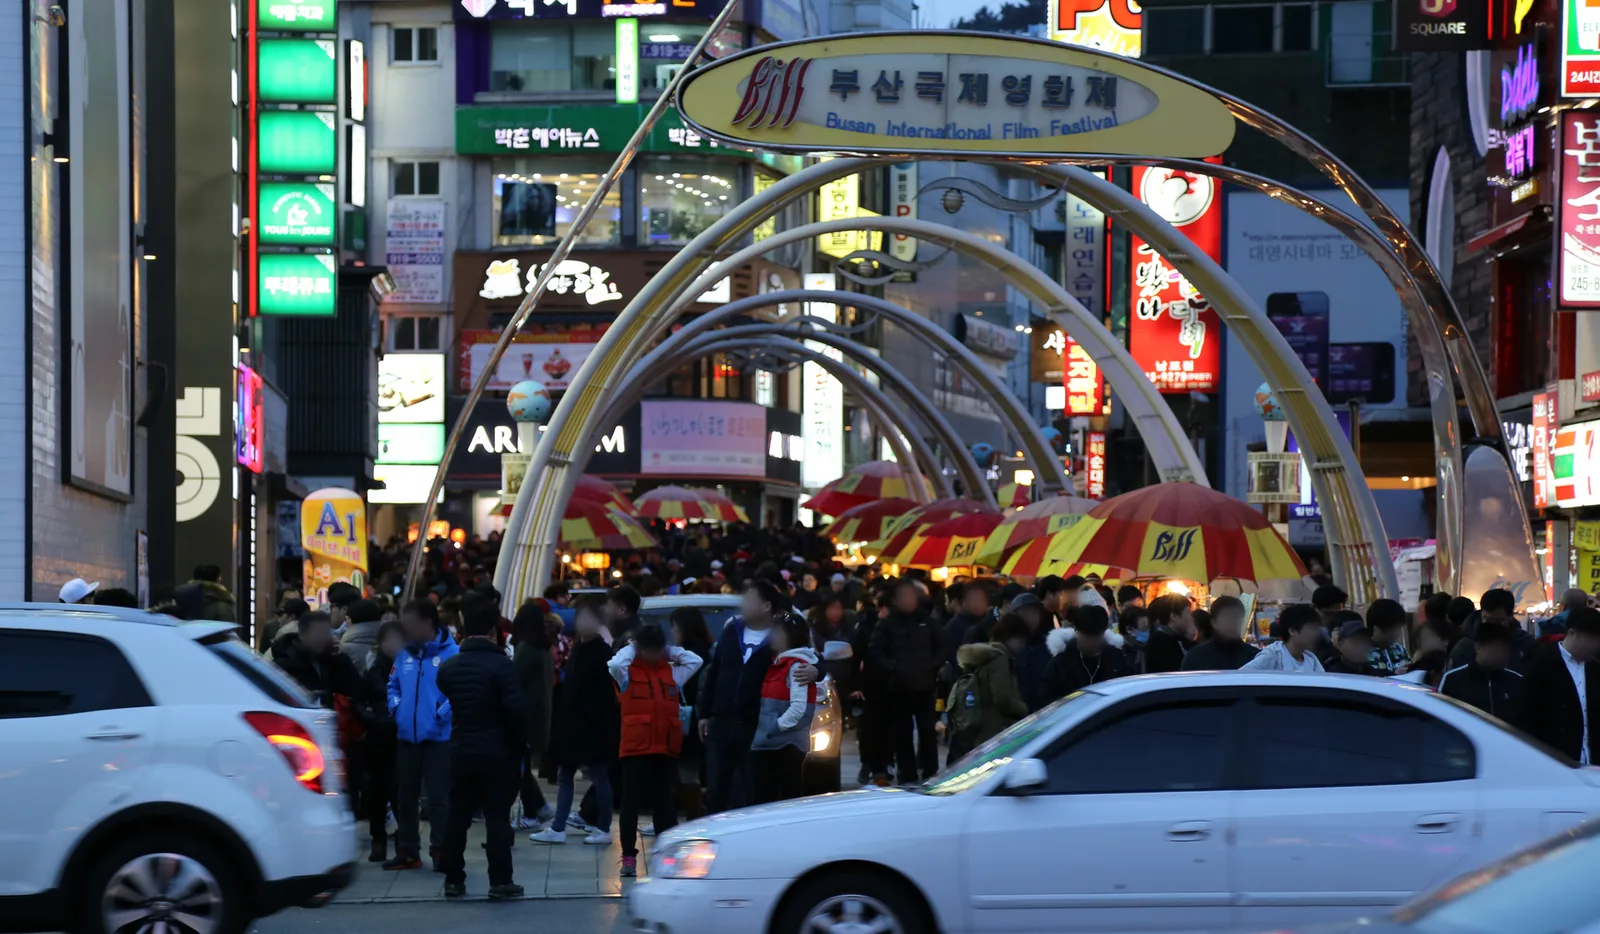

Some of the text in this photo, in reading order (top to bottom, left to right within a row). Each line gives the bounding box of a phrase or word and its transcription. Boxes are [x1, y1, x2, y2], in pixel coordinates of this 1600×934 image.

[1410, 22, 1467, 36] SQUARE
[829, 68, 1118, 110] 부산국제영화제
[826, 110, 1119, 140] Busan International Film Festival
[1249, 244, 1332, 262] 대영시네마
